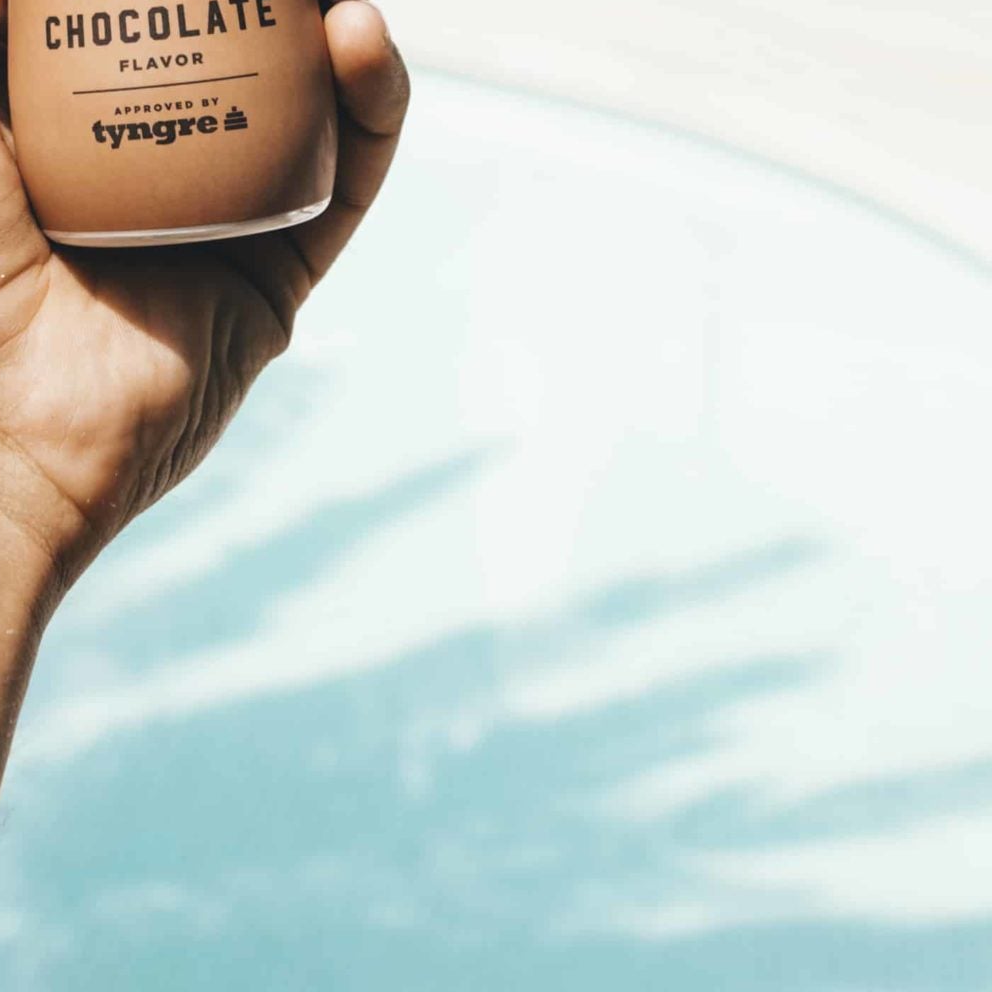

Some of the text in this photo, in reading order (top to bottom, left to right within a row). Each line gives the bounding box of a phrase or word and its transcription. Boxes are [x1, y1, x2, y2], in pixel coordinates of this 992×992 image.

[119, 52, 204, 72] FLAVOR
[114, 97, 220, 116] APPROVED BY
[92, 114, 218, 149] tyngre
